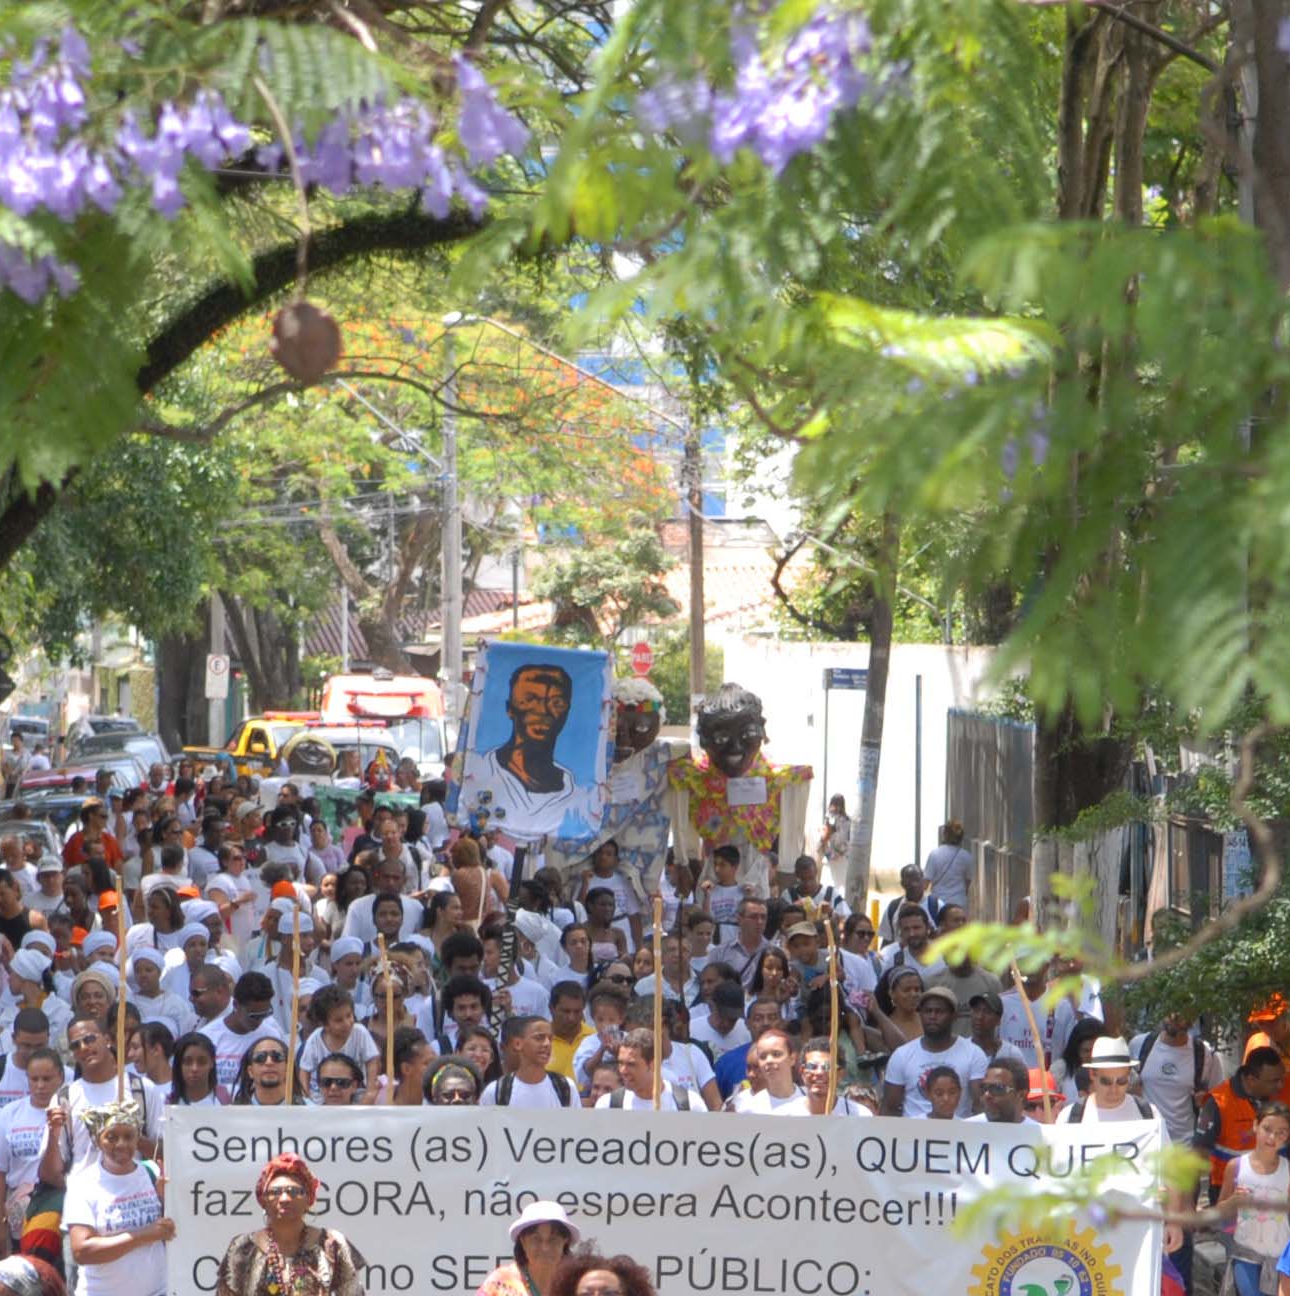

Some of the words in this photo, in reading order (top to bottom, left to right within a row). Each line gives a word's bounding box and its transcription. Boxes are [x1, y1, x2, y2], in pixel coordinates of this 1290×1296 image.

[192, 1127, 393, 1163] Senhores
[410, 1126, 488, 1171] (as)
[504, 1127, 838, 1179] Vereadores(as),
[856, 1136, 990, 1175] QUEM
[1008, 1141, 1141, 1180] QUER
[190, 1180, 253, 1216] faz
[311, 1180, 445, 1222] GORA,
[465, 1180, 539, 1216] não
[558, 1189, 697, 1225] espera
[710, 1184, 957, 1227] Acontecer!!!
[655, 1248, 871, 1296] PÚBLICO:
